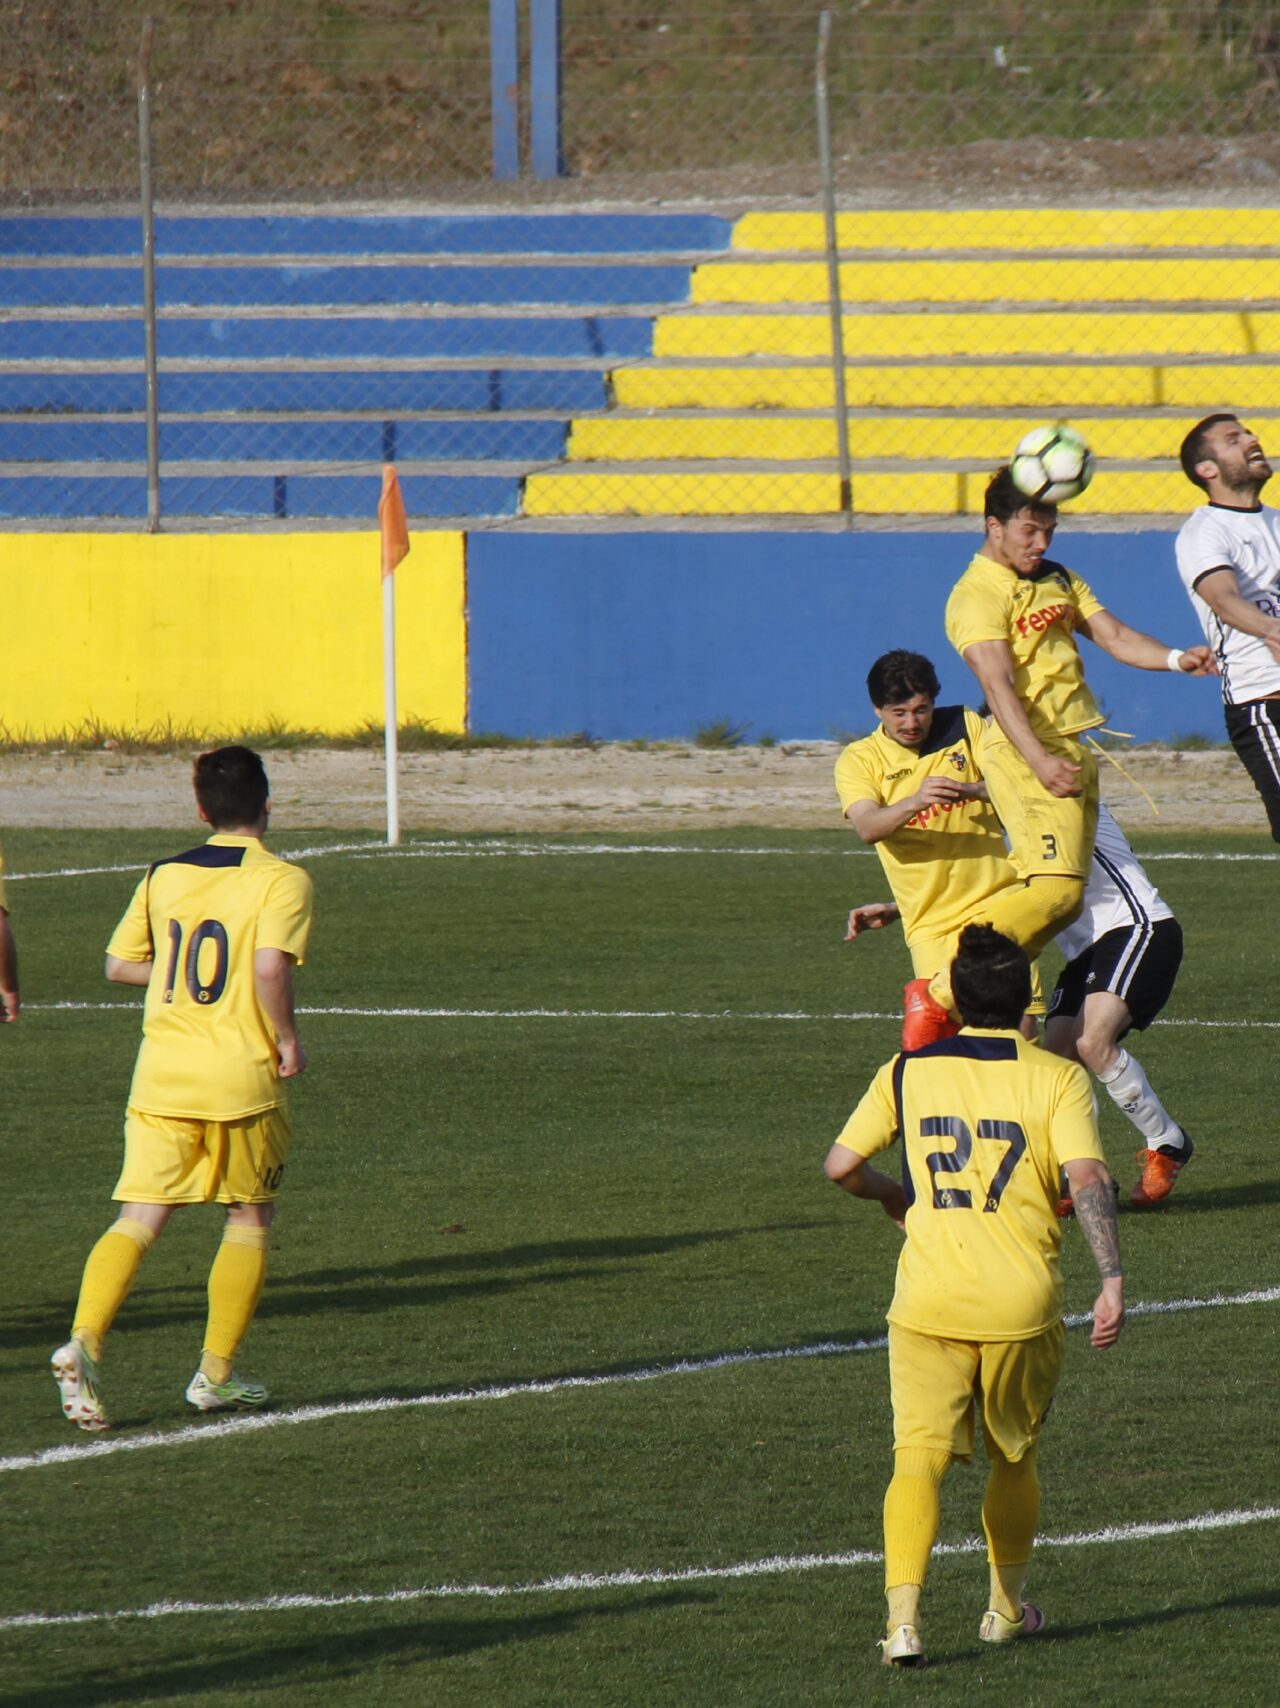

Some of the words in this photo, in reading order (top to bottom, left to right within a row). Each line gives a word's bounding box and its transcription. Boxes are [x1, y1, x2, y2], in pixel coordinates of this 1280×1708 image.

[1041, 834, 1057, 860] 3
[163, 918, 229, 1004] 10
[920, 1115, 1027, 1213] 27
